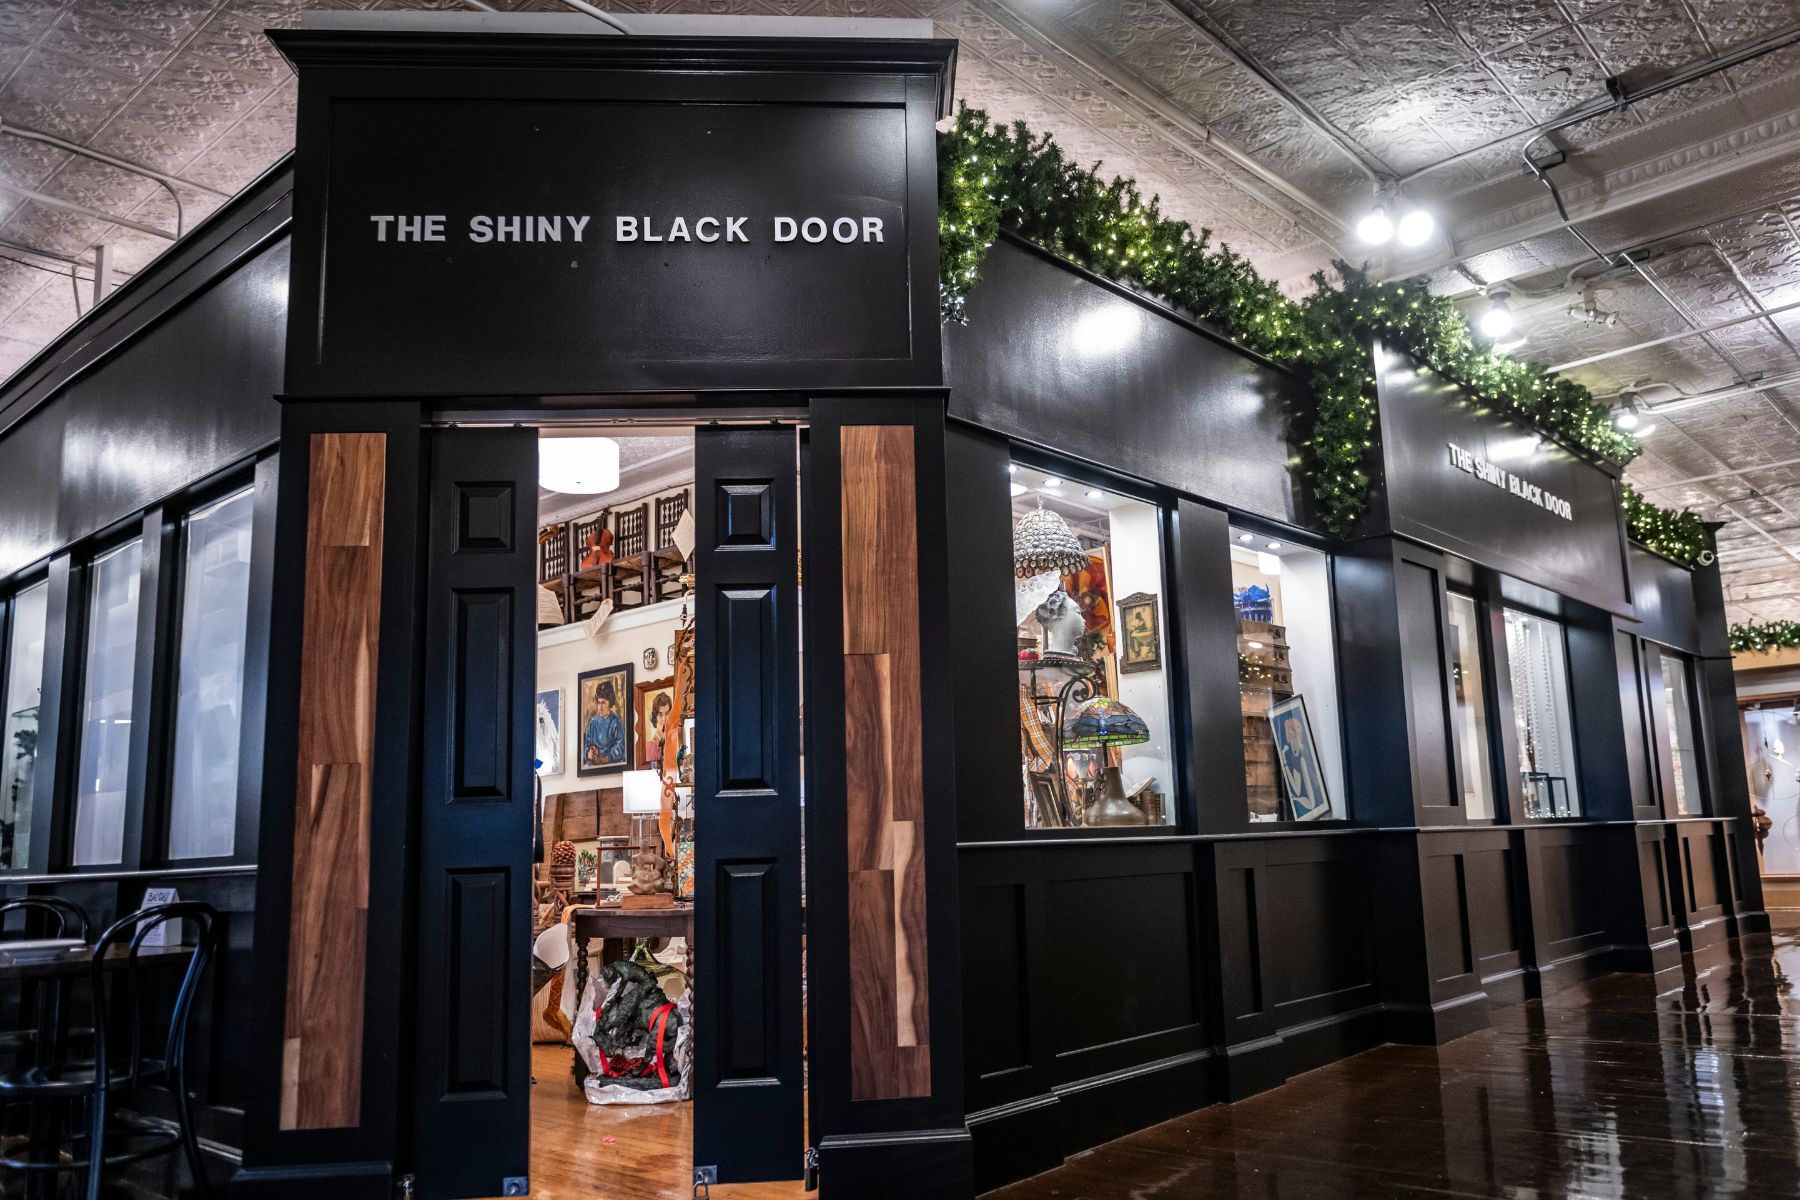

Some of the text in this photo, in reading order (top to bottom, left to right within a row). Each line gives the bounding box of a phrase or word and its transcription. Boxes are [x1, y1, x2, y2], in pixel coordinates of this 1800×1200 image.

[370, 215, 885, 243] THE SHINY BLACK DOOR
[1448, 442, 1573, 521] THE SHINY BLACK DOOR
